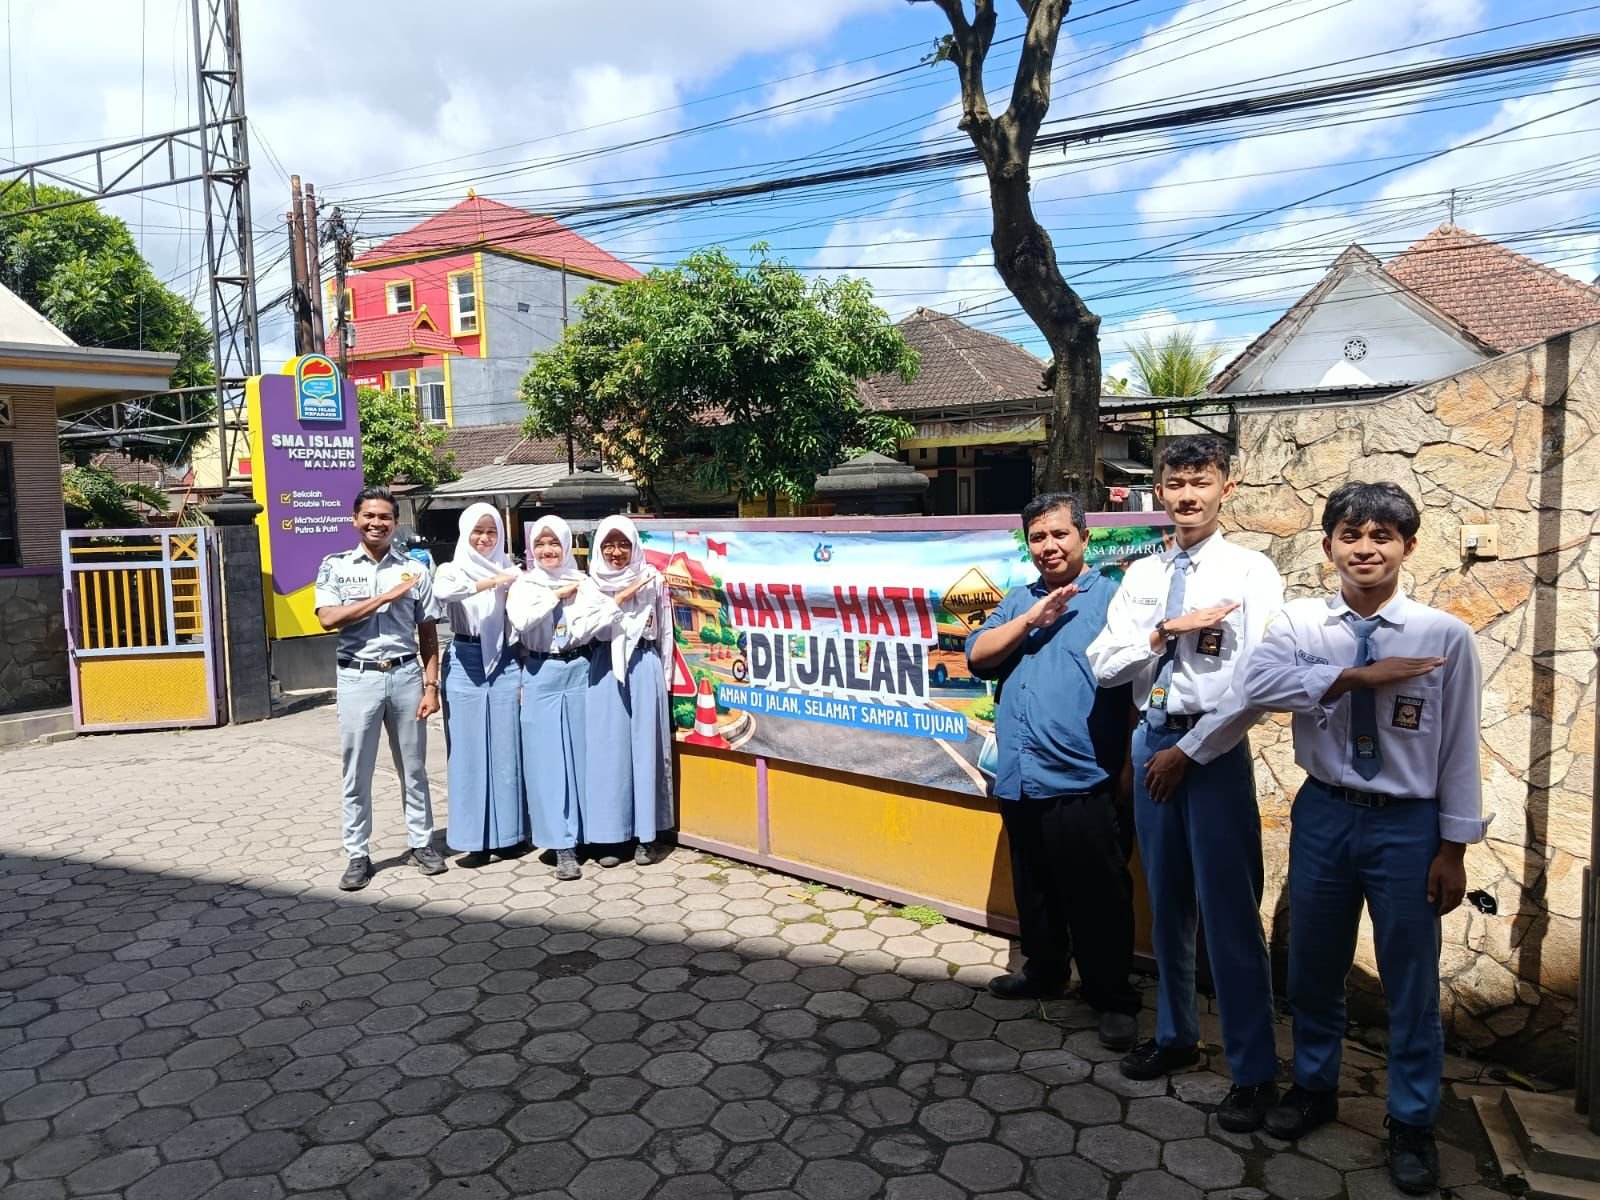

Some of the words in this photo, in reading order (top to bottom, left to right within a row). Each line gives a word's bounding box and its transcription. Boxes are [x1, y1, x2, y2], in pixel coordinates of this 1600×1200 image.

[271, 434, 305, 447] SMA
[309, 435, 354, 448] ISLAM
[288, 448, 355, 459] KEPANJEN
[304, 460, 356, 468] MALANG
[292, 490, 322, 498] Sekolah
[322, 525, 338, 533] Putri
[1084, 545, 1105, 555] ASA
[1108, 544, 1165, 555] RAHARJA
[950, 592, 994, 606] HATI-HATI
[726, 582, 932, 639] HATI-HATI
[750, 633, 785, 683] DI
[796, 636, 924, 697] JALAN
[720, 686, 747, 705] AMAN
[750, 691, 762, 707] DI
[765, 694, 801, 715] JALAN,
[804, 699, 857, 721] SELAMAT
[861, 706, 909, 728] SAMPAI
[912, 712, 964, 735] TUJUAN
